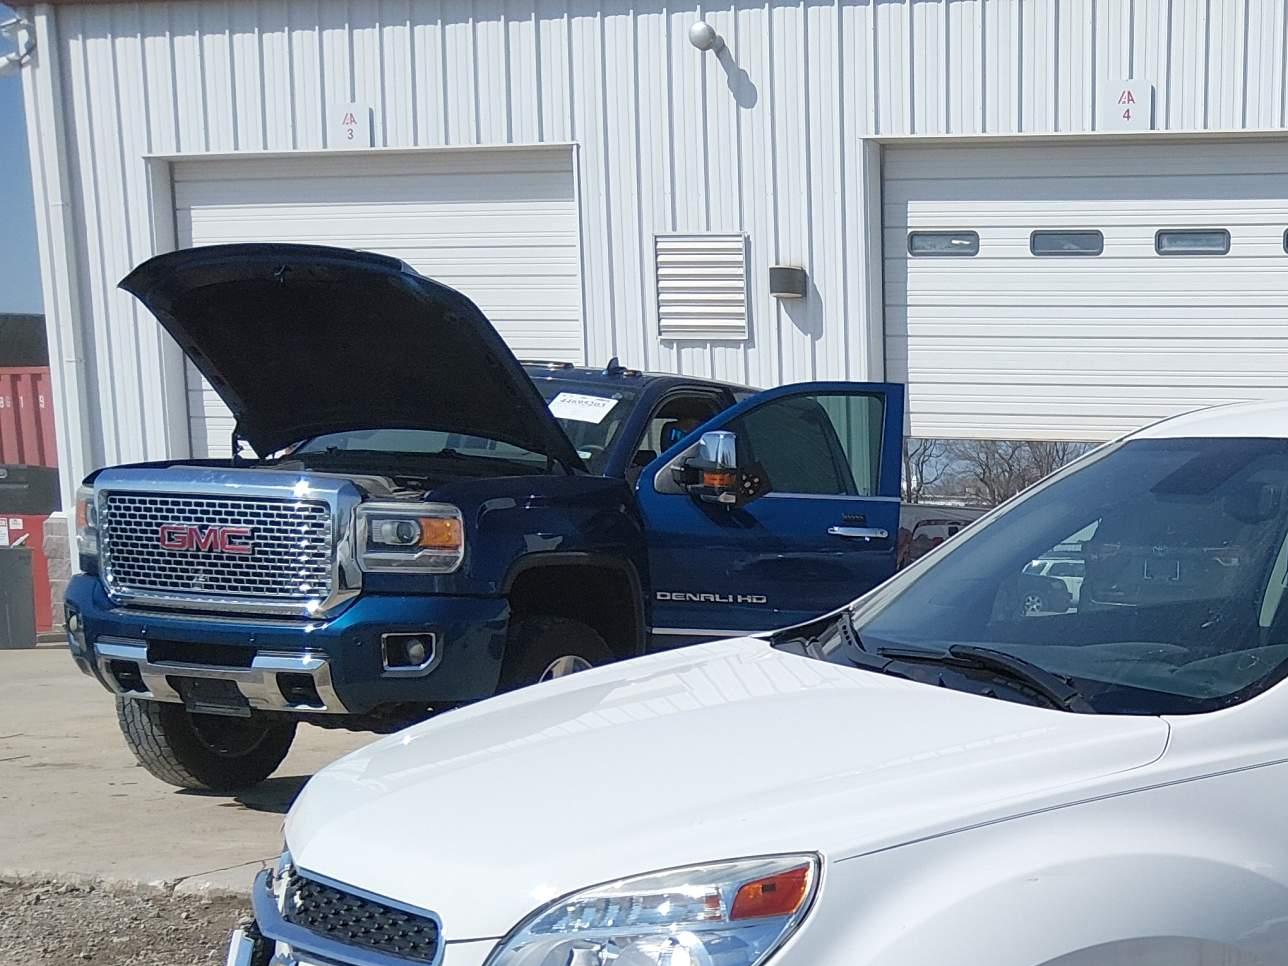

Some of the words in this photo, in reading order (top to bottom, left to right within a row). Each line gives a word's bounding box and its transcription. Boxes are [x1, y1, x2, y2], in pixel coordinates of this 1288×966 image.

[1122, 108, 1131, 121] 4
[347, 128, 354, 141] 3
[160, 524, 253, 554] GMC
[656, 591, 733, 603] DENALI
[737, 595, 767, 604] HD
